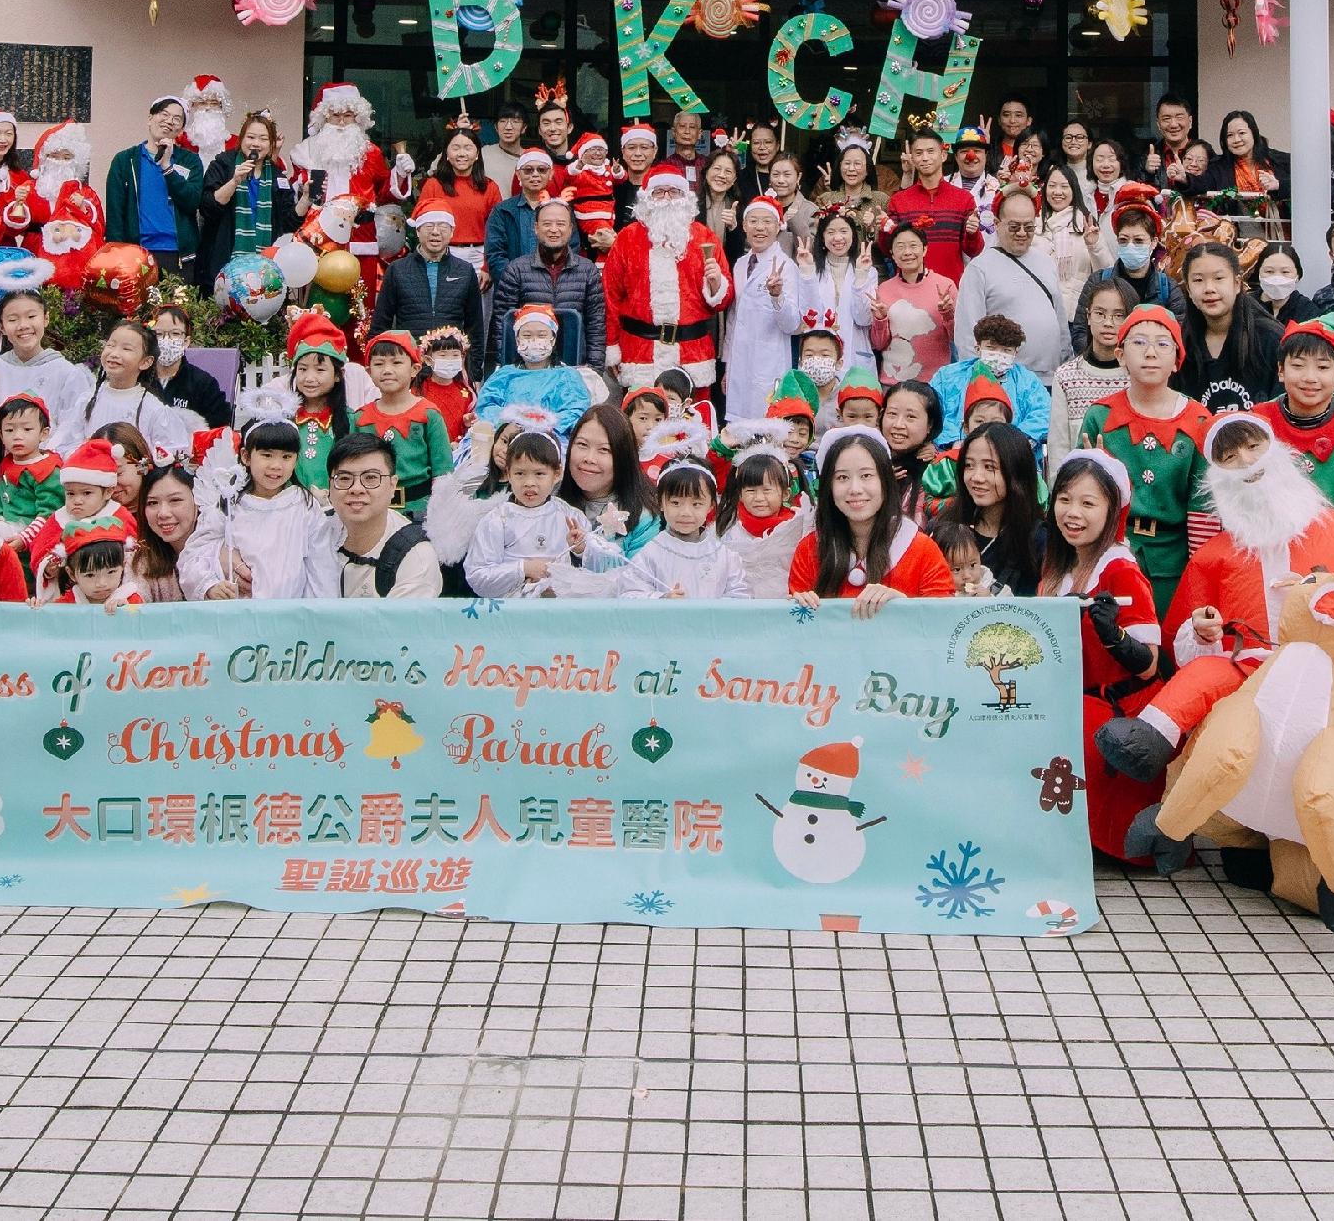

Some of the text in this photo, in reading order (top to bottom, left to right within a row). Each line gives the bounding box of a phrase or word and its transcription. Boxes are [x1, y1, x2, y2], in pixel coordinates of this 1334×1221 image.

[767, 13, 854, 131] C
[869, 18, 983, 144] H
[1210, 377, 1254, 410] balance
[52, 651, 94, 714] of
[105, 649, 210, 693] Kent
[227, 640, 429, 687] Children's
[443, 643, 621, 709] Hospital
[632, 659, 680, 699] at
[696, 657, 841, 728] Sandy
[855, 669, 959, 739] Bay
[116, 713, 619, 772] Christmas Parade
[41, 791, 726, 854] 大口環根德公爵夫人兒童醫院
[278, 856, 474, 894] 聖誕巡遊
